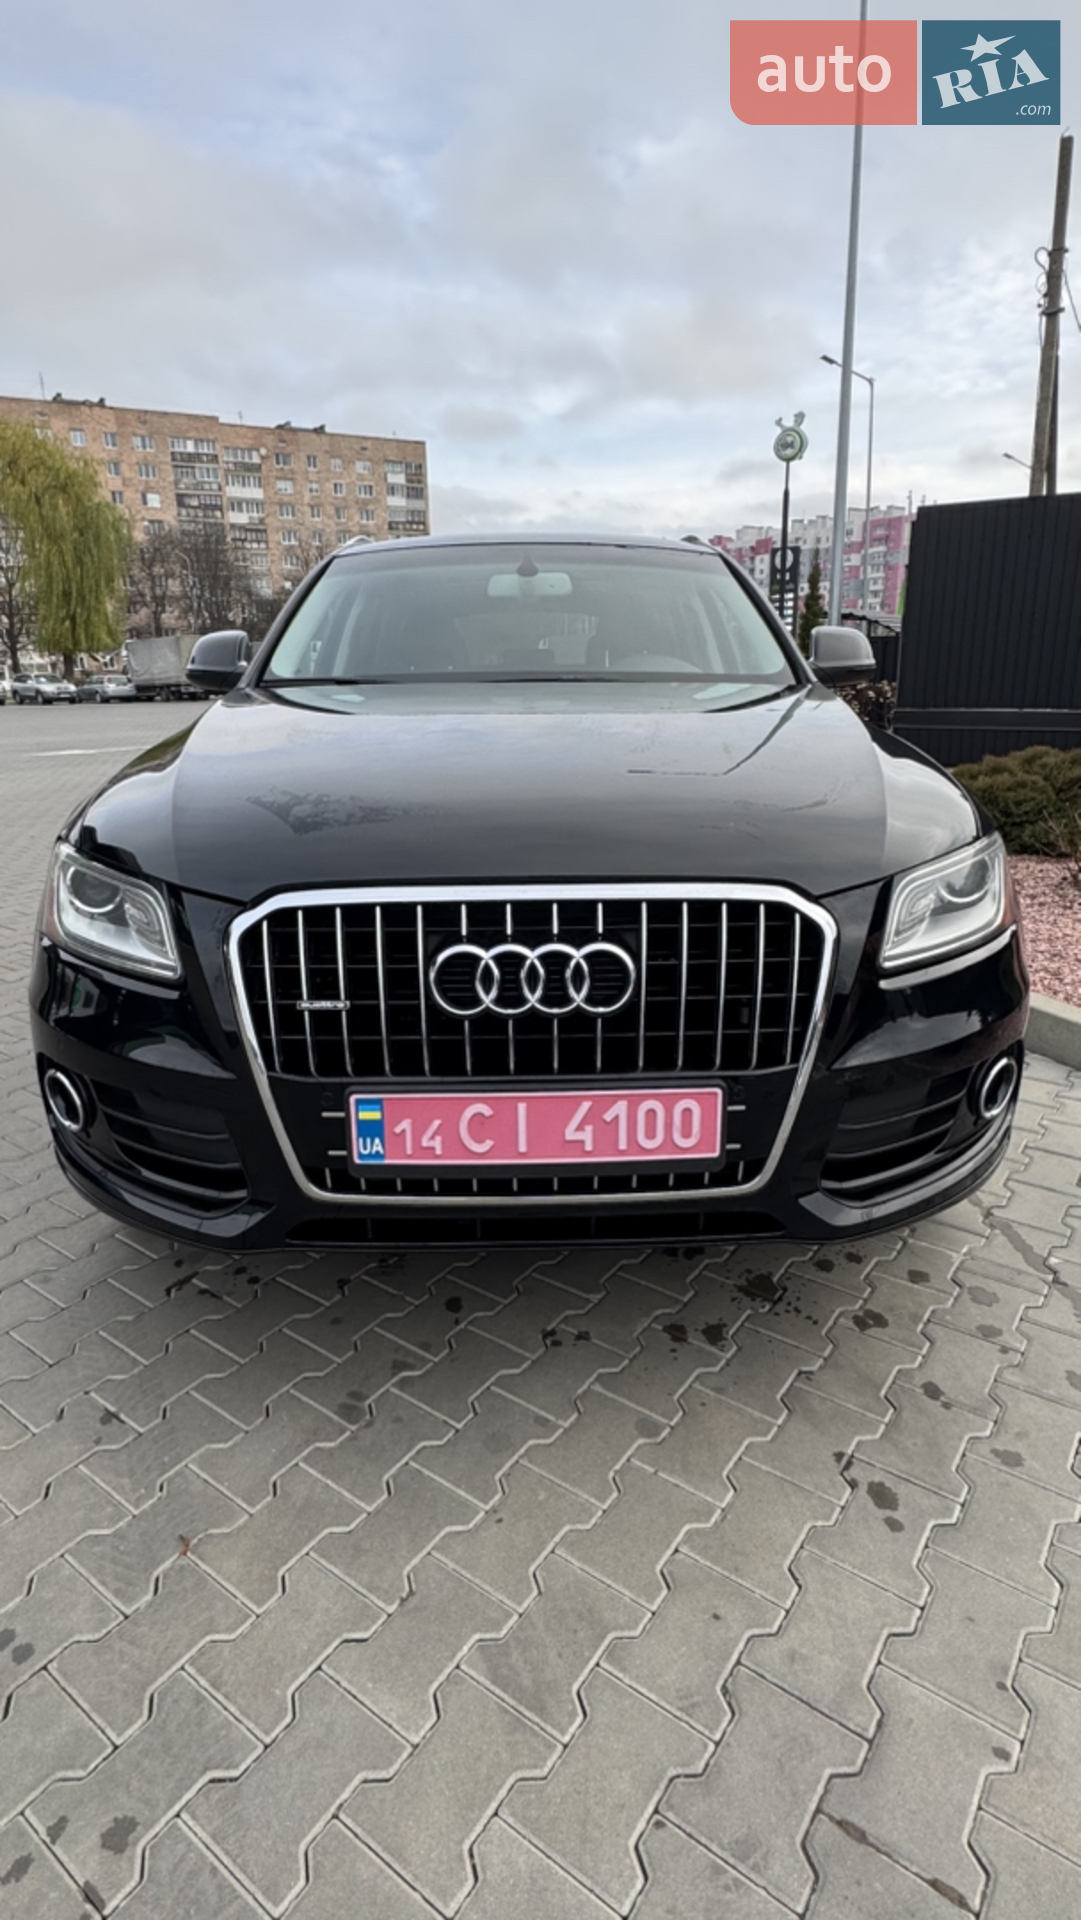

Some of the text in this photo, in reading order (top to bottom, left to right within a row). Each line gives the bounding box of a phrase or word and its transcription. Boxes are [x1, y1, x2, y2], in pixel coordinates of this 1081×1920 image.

[393, 1118, 443, 1155] 14
[564, 1098, 702, 1152] 4100
[358, 1137, 384, 1155] UA
